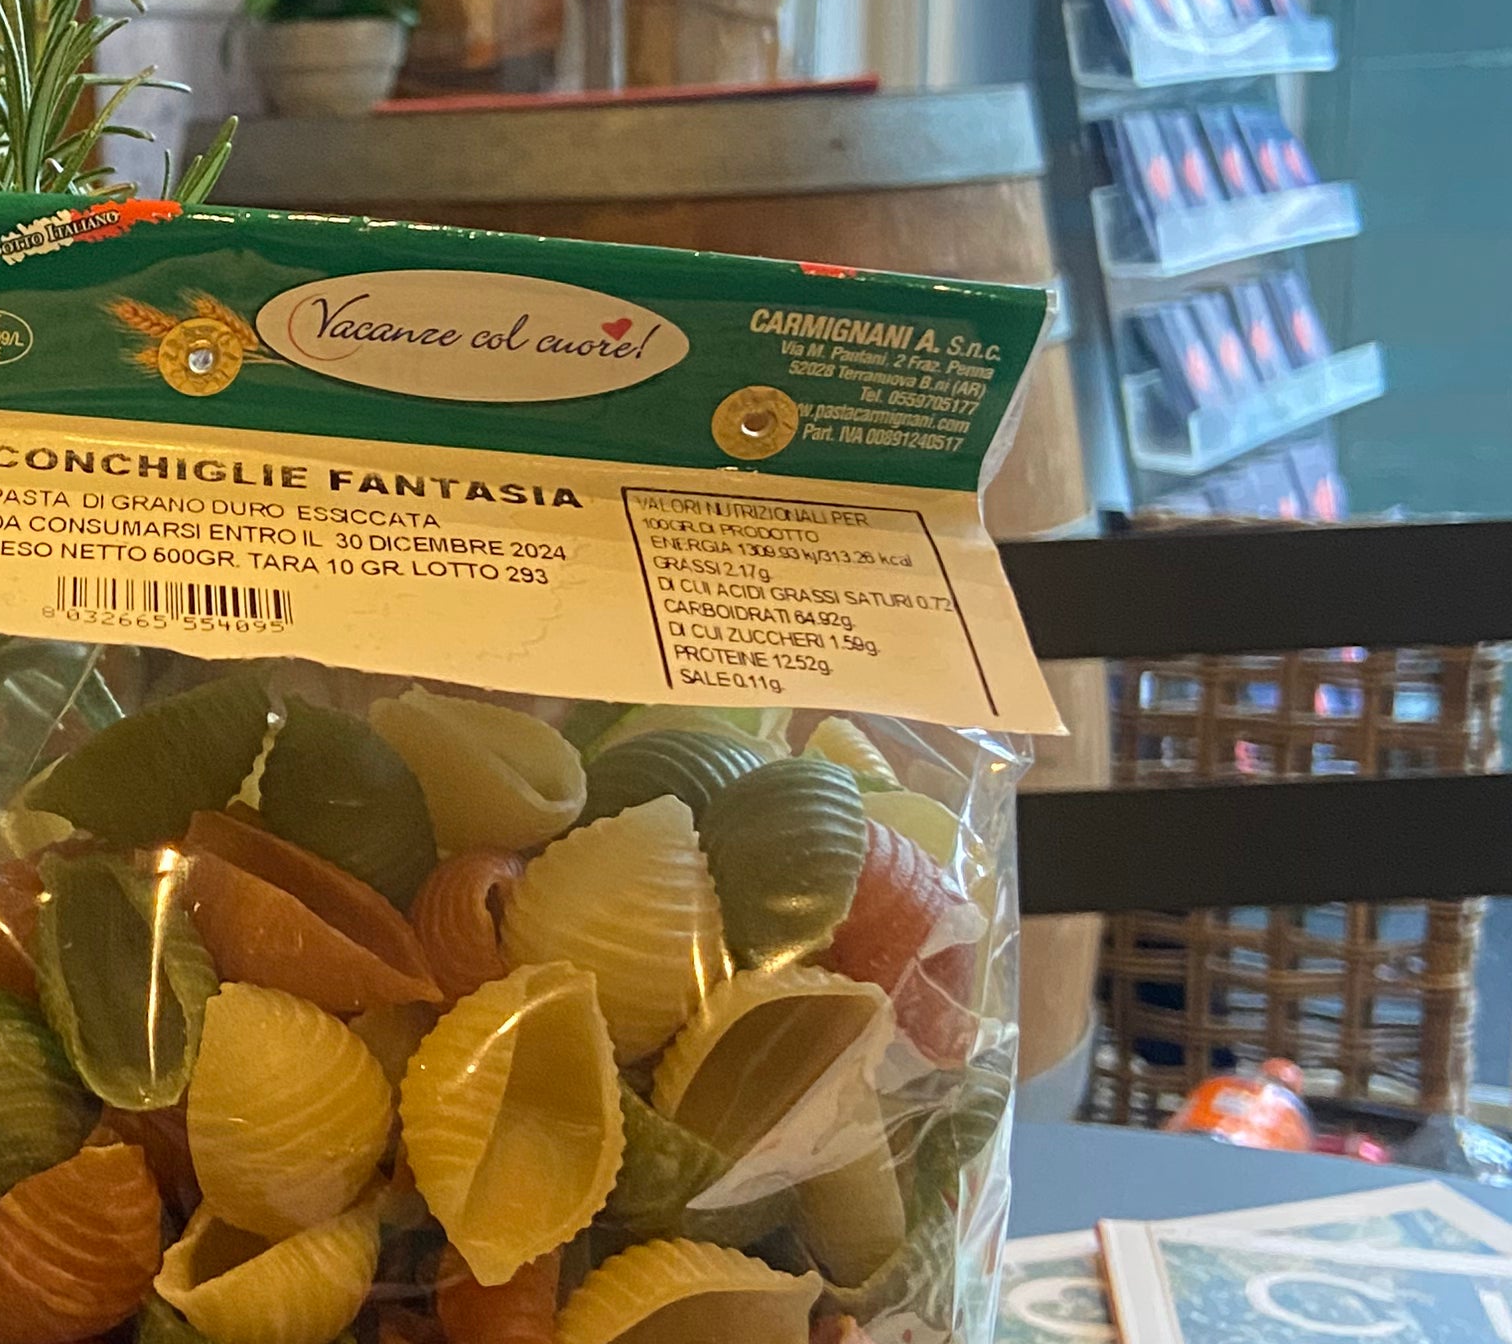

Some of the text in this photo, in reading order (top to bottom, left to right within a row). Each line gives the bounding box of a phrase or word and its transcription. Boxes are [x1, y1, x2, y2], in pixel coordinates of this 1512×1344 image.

[45, 210, 122, 242] ITALIANO
[311, 293, 661, 359] Vacanze col cuore!
[749, 308, 915, 351] CARMIGNANI
[914, 328, 942, 354] A.
[781, 340, 804, 356] Via
[893, 354, 906, 368] 2
[789, 360, 836, 378] 52028
[951, 381, 987, 399] (AR)
[860, 386, 884, 403] Tel.
[839, 427, 864, 443] IVA
[329, 468, 584, 509] FANTASIA
[83, 493, 105, 509] DI
[111, 495, 205, 514] GRANO
[212, 500, 284, 519] DURO
[297, 506, 441, 529] ESSICCATA
[634, 496, 872, 528] VALORI NUTRIZIONALI PER
[29, 516, 201, 540] CONSUMARSI
[210, 524, 297, 546] ENTRO
[303, 530, 324, 547] IL
[336, 533, 363, 551] 30
[370, 535, 505, 556] DICEMBRE
[509, 542, 567, 561] 2024
[720, 523, 819, 543] PRODOTTO
[61, 543, 147, 562] NETTO
[248, 553, 320, 574] TARA
[327, 559, 355, 575] 10
[412, 561, 499, 580] LOTTO
[506, 566, 549, 585] 293
[650, 535, 733, 554] ENERGIA
[878, 552, 913, 568] kcal
[653, 556, 721, 575] GRASSI
[658, 576, 674, 592] DI
[680, 579, 711, 596] CUI
[717, 583, 766, 601] ACIDI
[770, 587, 840, 605] GRASSI
[844, 591, 913, 608] SATURI
[42, 605, 285, 633] 8 032665 554095
[663, 598, 791, 624] CARBOIDRATI
[669, 621, 685, 637] DI
[692, 623, 723, 641] CUI
[728, 627, 825, 649] ZUCCHERI
[674, 645, 769, 668] PROTEINE
[680, 668, 732, 687] SALE
